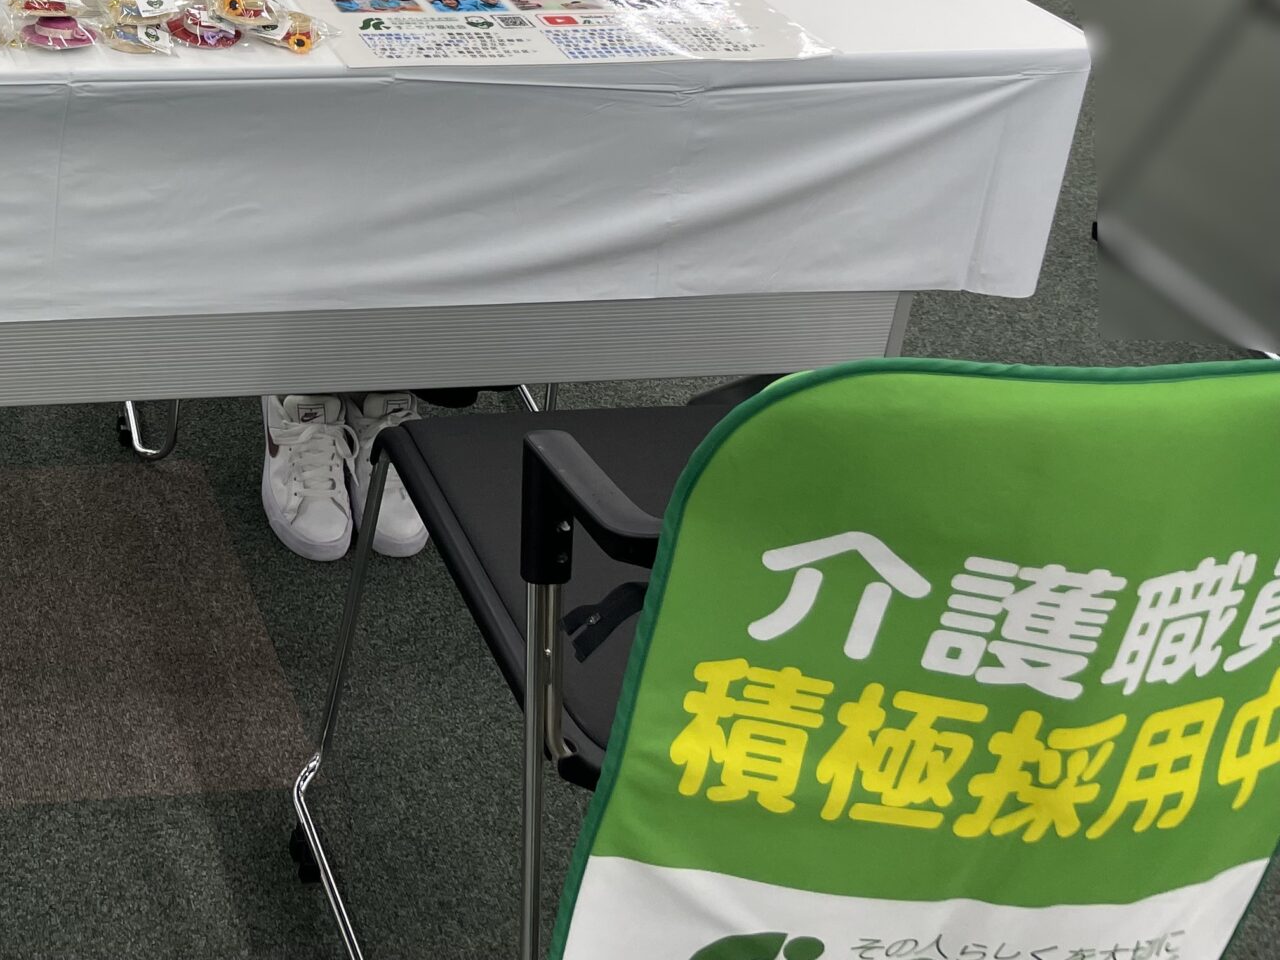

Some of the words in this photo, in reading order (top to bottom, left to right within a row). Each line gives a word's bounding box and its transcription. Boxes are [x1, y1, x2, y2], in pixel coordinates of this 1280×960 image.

[669, 657, 1280, 843] 積極採用中
